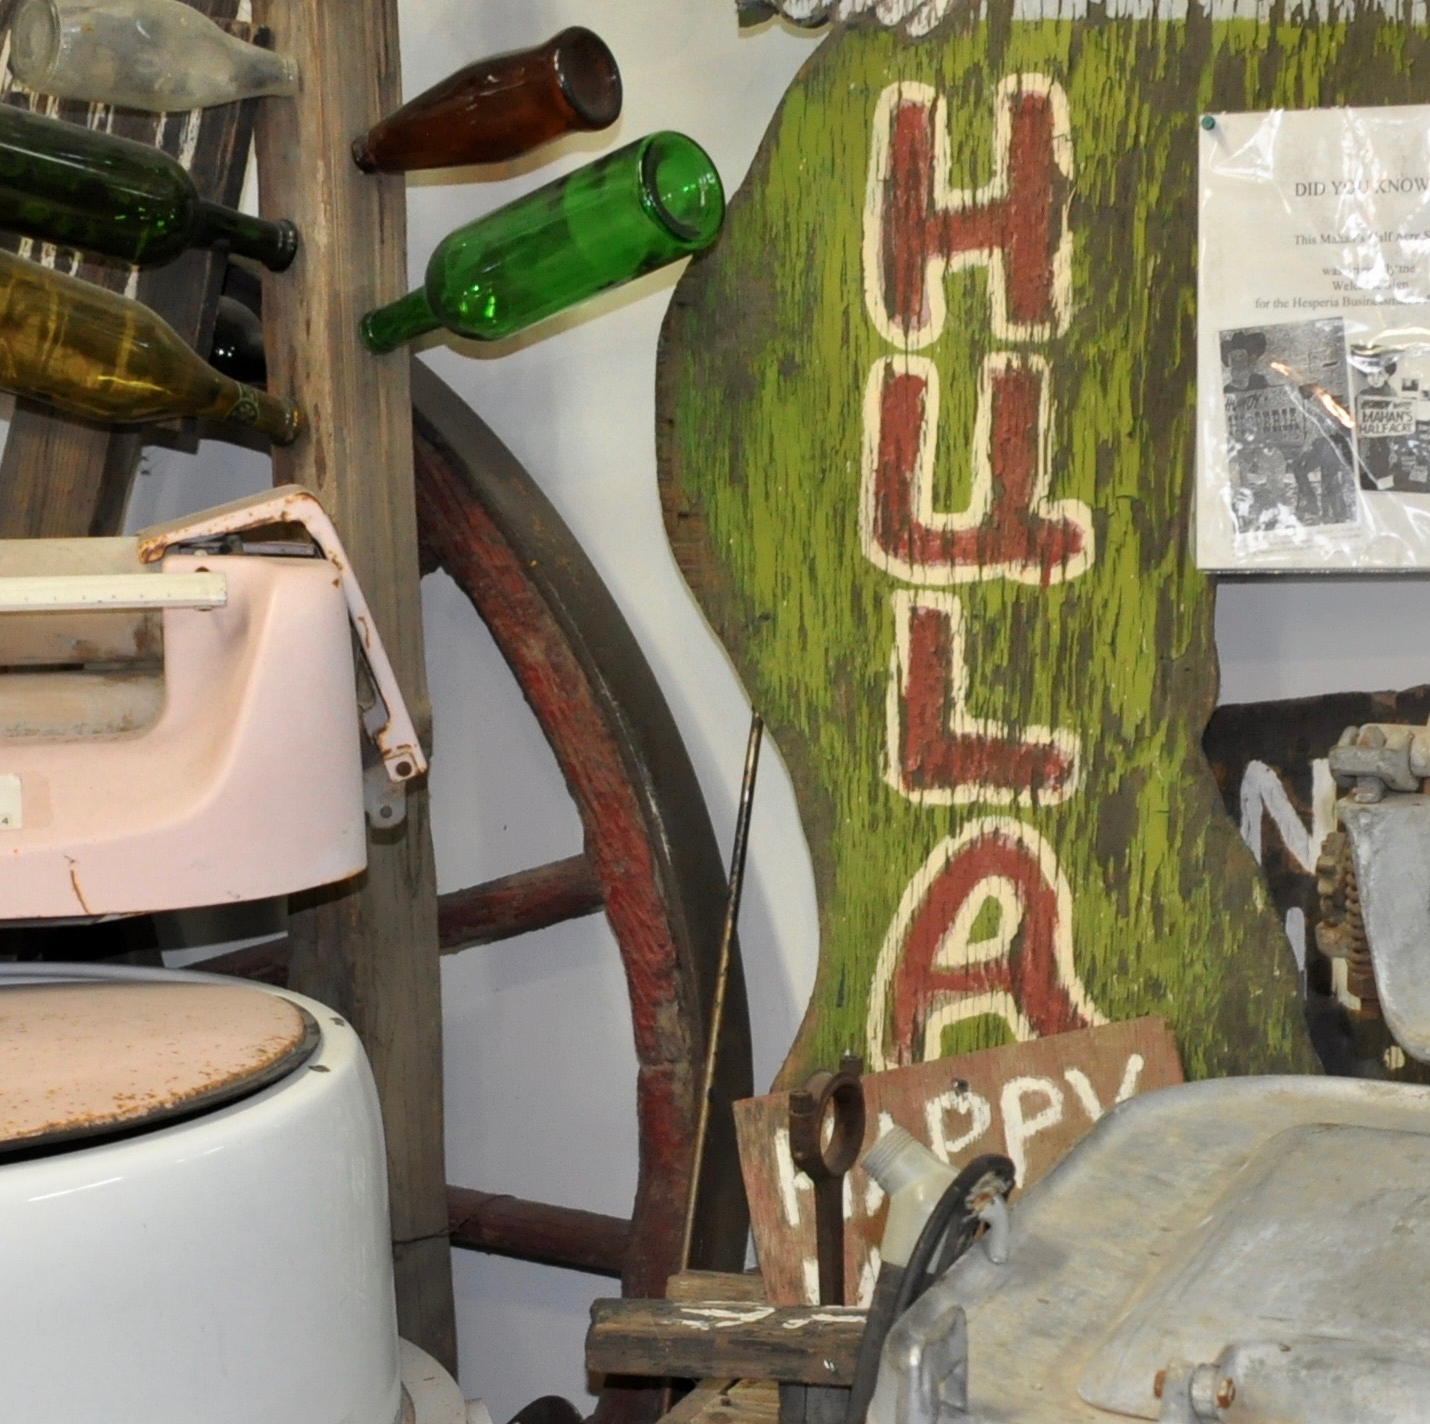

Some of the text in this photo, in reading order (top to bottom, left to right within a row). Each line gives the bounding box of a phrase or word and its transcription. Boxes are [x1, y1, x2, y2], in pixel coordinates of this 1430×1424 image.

[1295, 181, 1326, 197] DID
[1294, 235, 1317, 246] This
[1255, 298, 1270, 309] for
[1272, 298, 1289, 308] the
[1292, 298, 1340, 310] Hesperia
[774, 1053, 1144, 1227] HPPY
